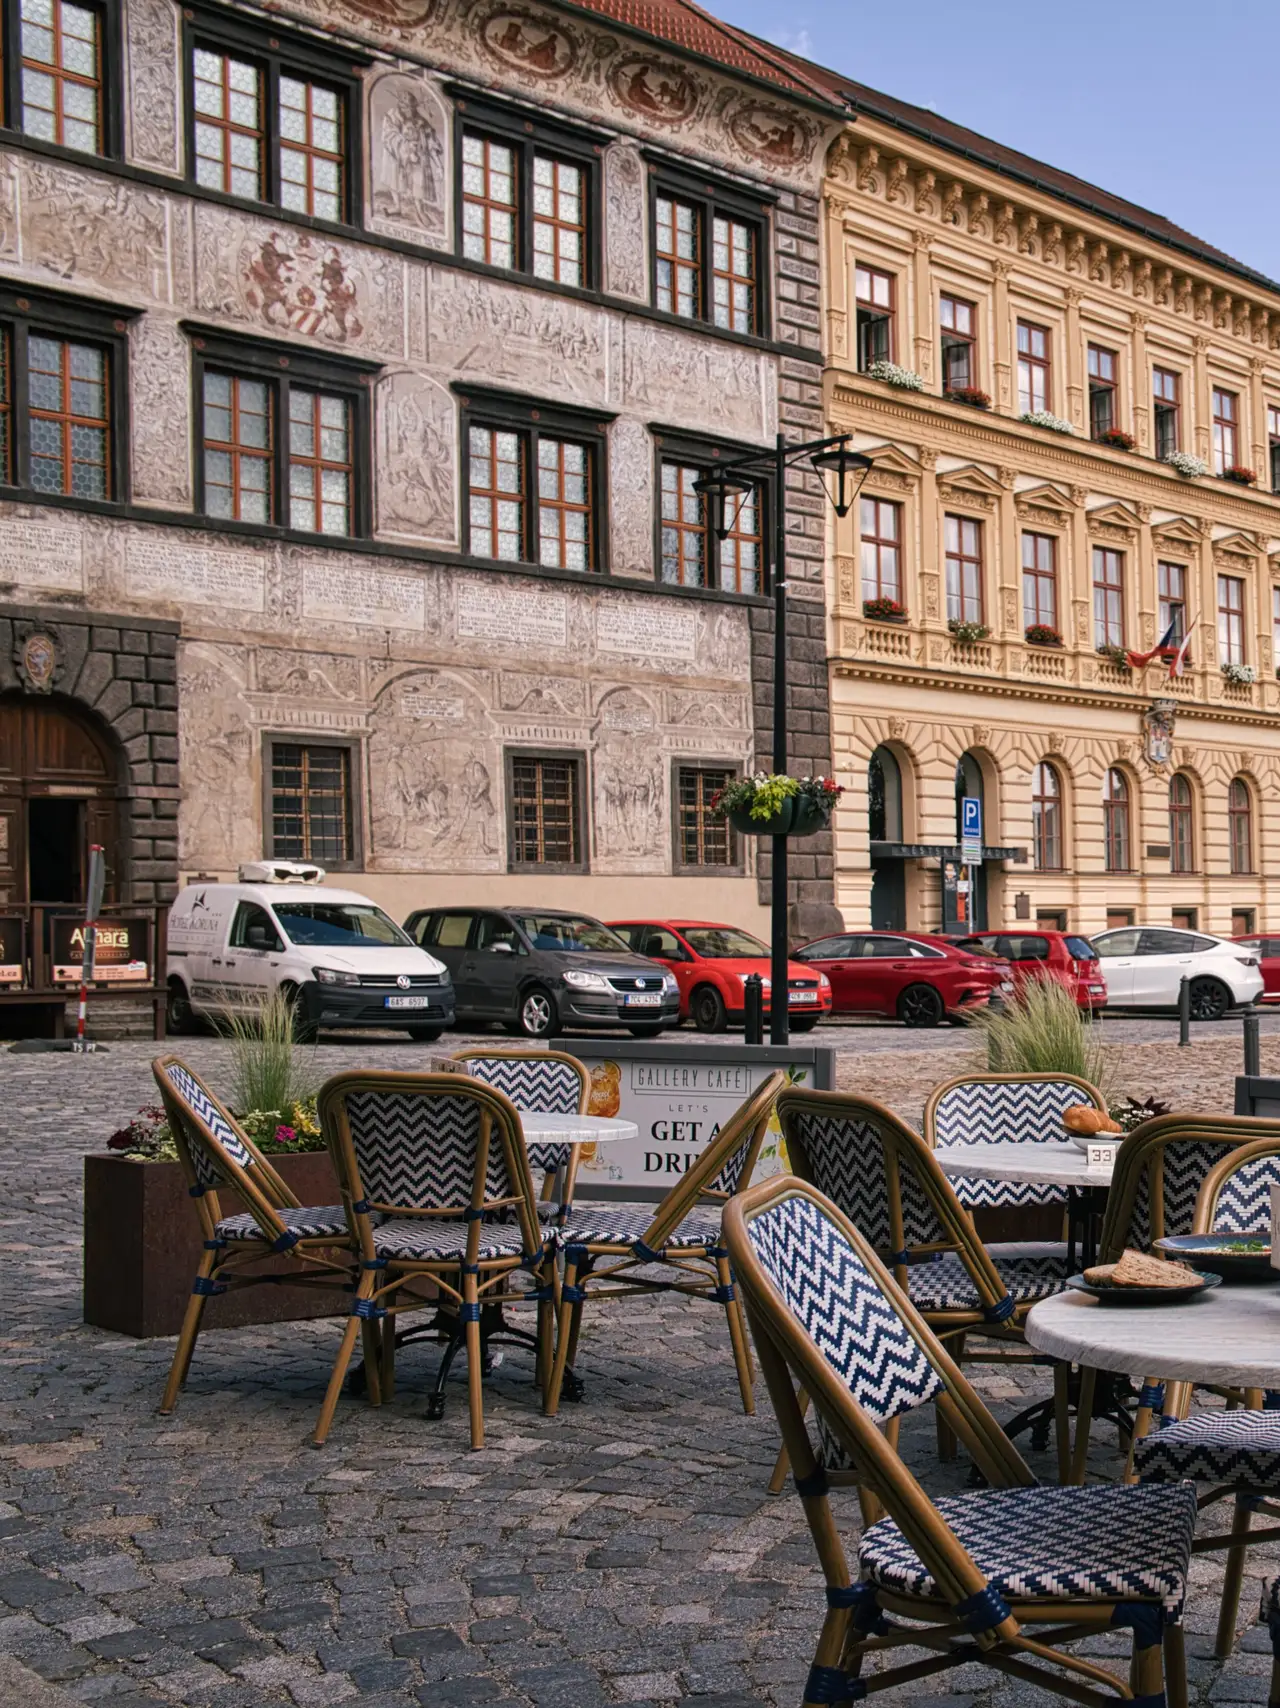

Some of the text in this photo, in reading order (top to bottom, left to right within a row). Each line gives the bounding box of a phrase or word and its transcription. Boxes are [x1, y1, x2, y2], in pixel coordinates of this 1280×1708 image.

[966, 803, 977, 826] P
[638, 1067, 741, 1089] GALLERY CAFÉ
[669, 1104, 709, 1113] LET'S
[651, 1120, 703, 1142] GET
[643, 1151, 699, 1174] DRI
[1092, 1149, 1111, 1162] 33
